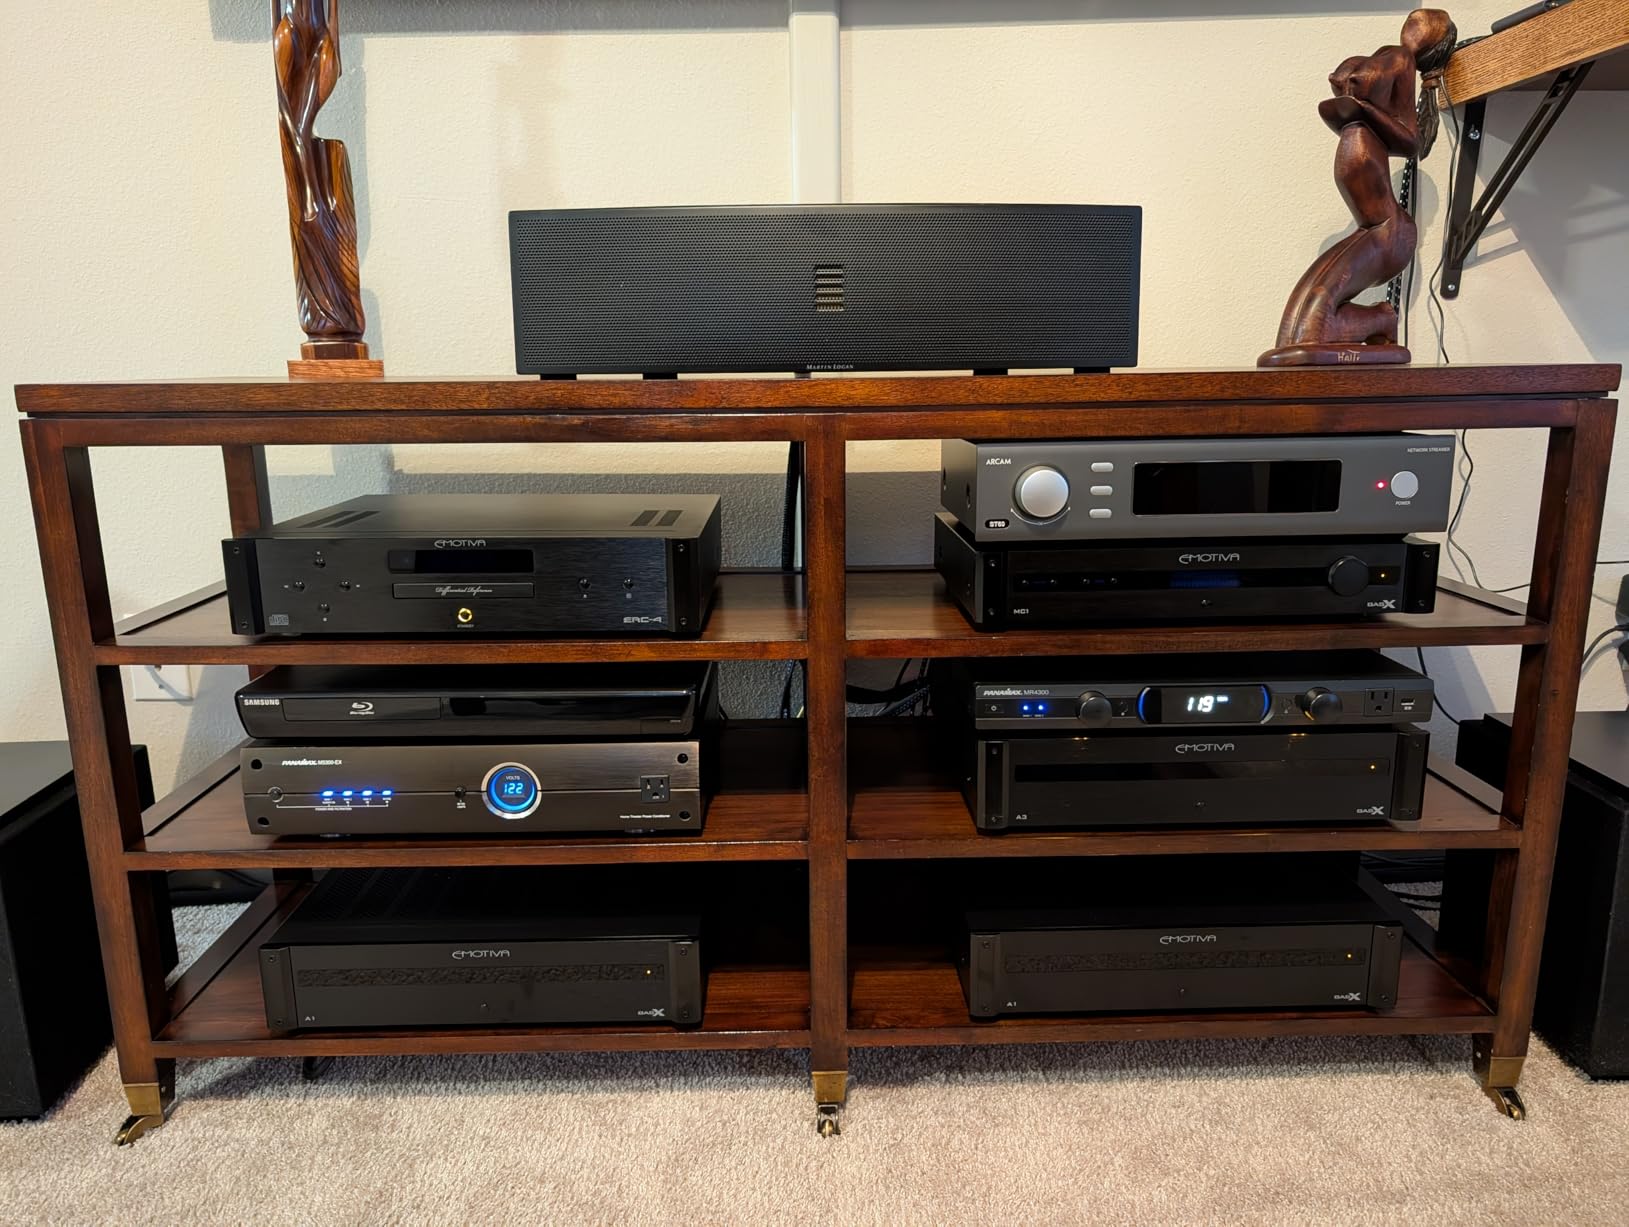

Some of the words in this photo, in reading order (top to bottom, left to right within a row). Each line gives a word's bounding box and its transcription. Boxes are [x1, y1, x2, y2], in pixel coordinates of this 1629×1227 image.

[434, 539, 487, 548] EMOTIVA
[1178, 553, 1240, 564] EMOTIVA
[1175, 743, 1235, 753] EMOTIVA
[504, 782, 524, 794] 122
[1159, 935, 1217, 944] EMOTIVA
[452, 950, 510, 959] EMOTIVA
